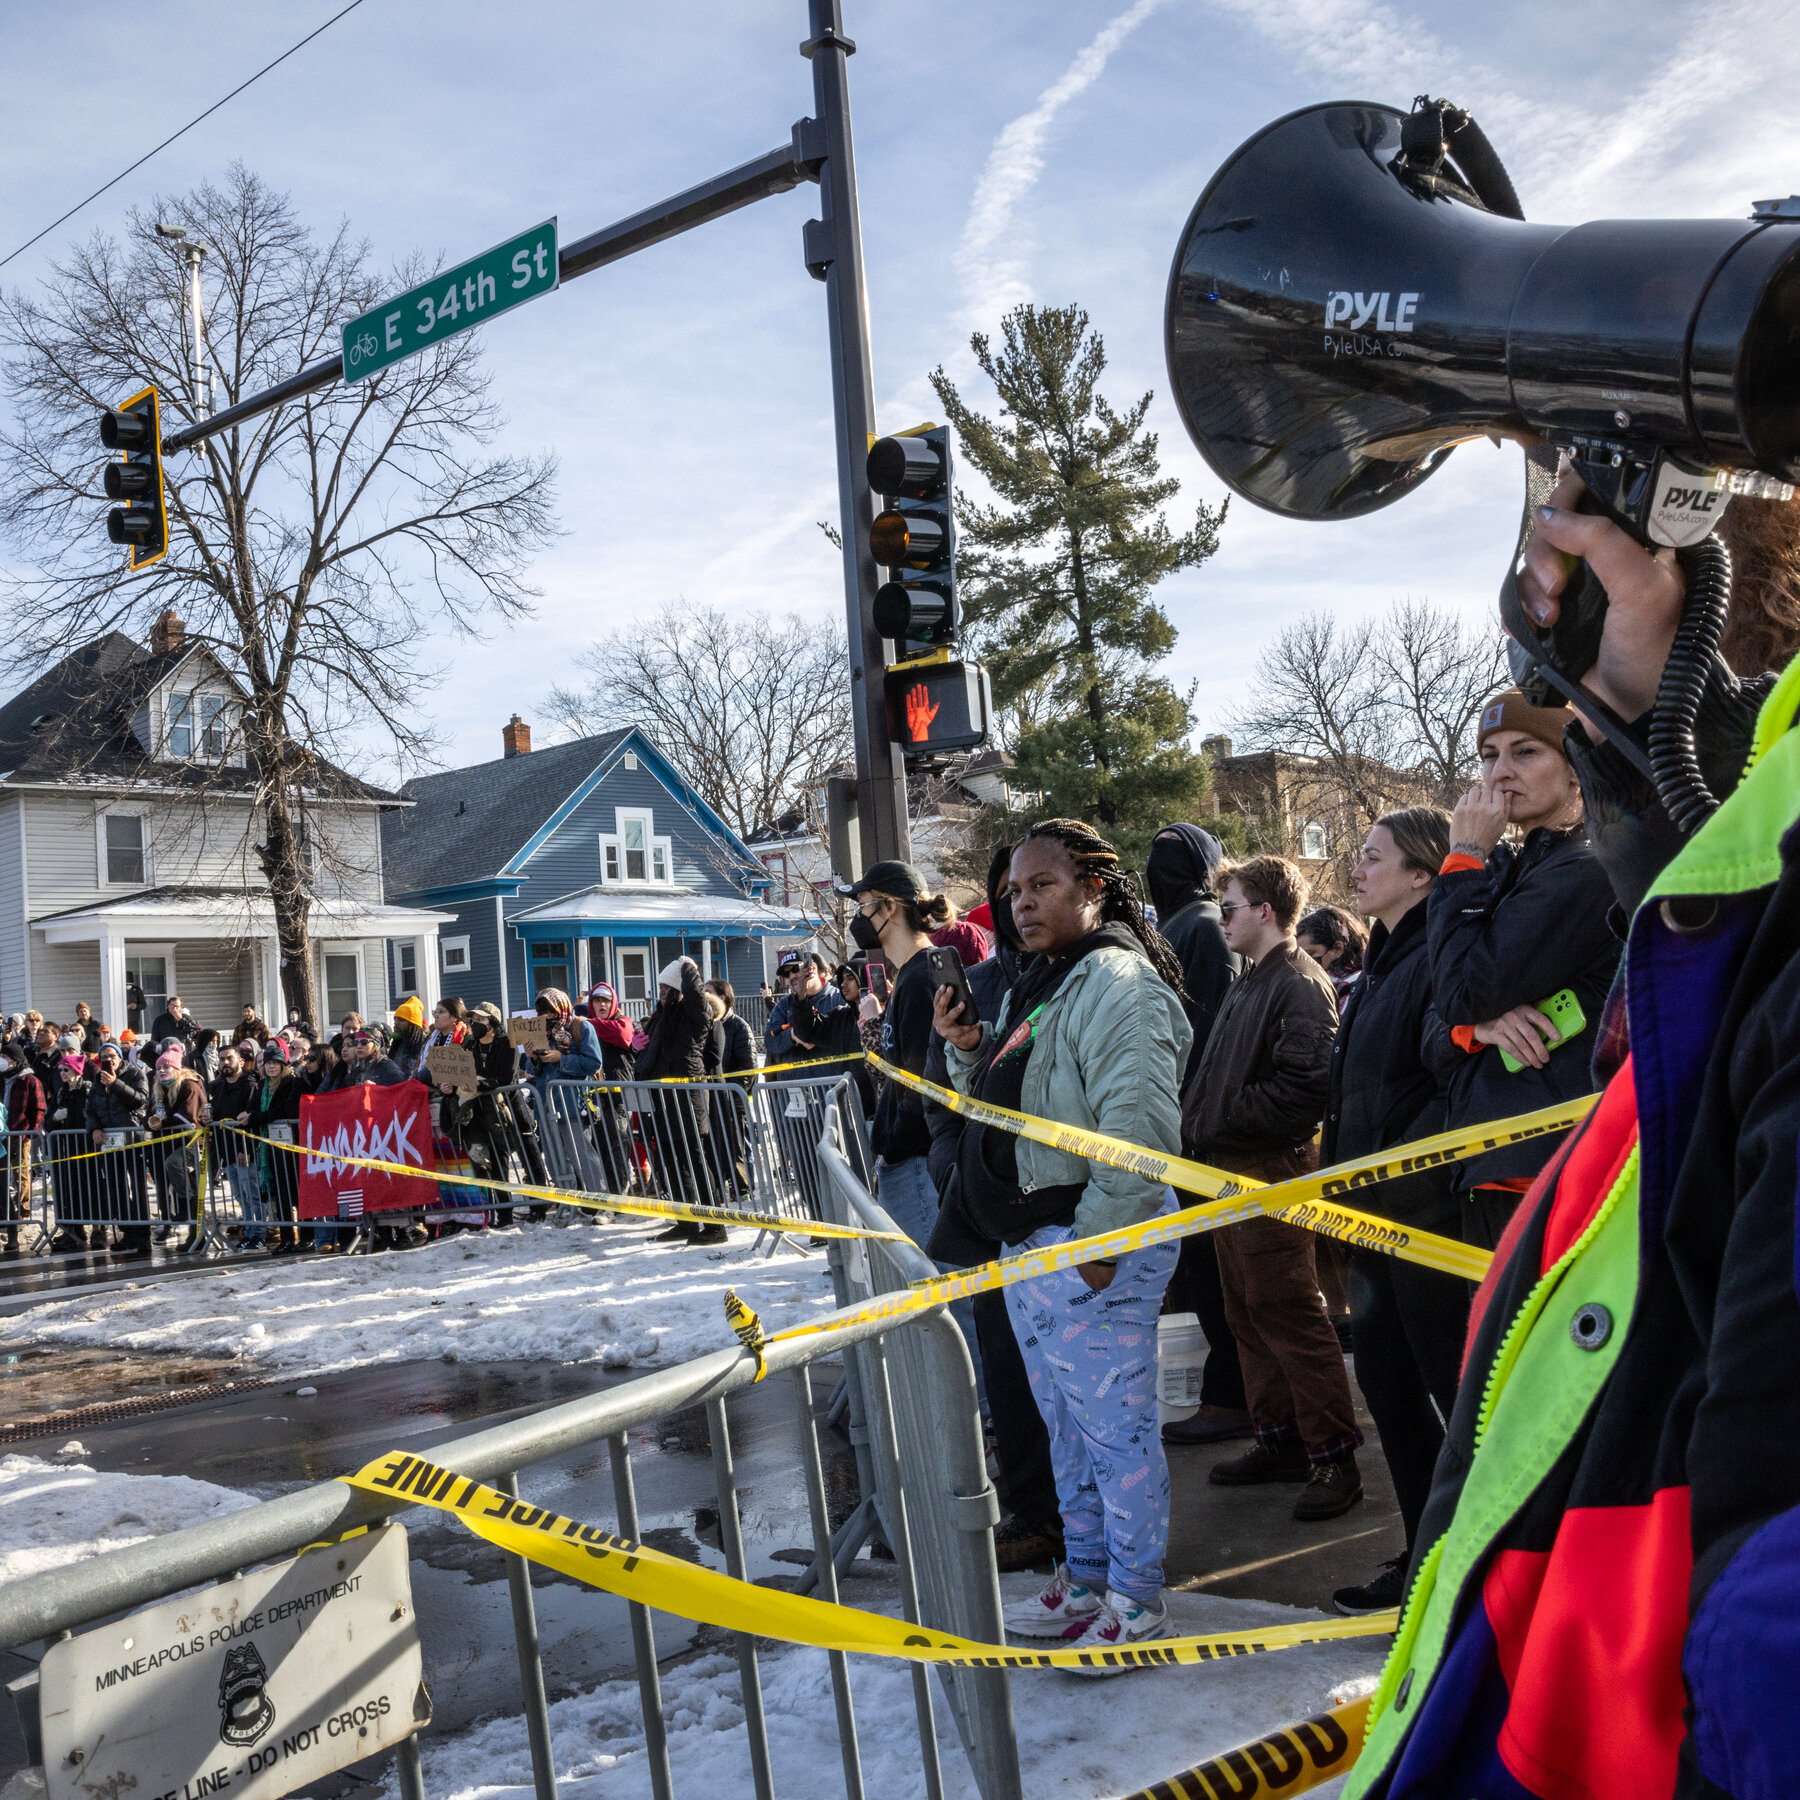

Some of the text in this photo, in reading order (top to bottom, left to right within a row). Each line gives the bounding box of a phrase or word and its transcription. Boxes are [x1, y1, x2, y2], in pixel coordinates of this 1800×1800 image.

[385, 241, 548, 352] E 34th St
[1324, 291, 1419, 332] PYLE
[1662, 487, 1718, 512] PYLE
[431, 1049, 446, 1060] ICE
[371, 1456, 480, 1508] LINE
[95, 1575, 362, 1692] MINNEAPOLIS POLICE DEPARTMENT
[184, 1766, 231, 1800] LINE
[248, 1746, 278, 1776] DO
[282, 1723, 321, 1760] NOT
[326, 1695, 391, 1738] CROSS
[232, 1716, 266, 1737] POLICE
